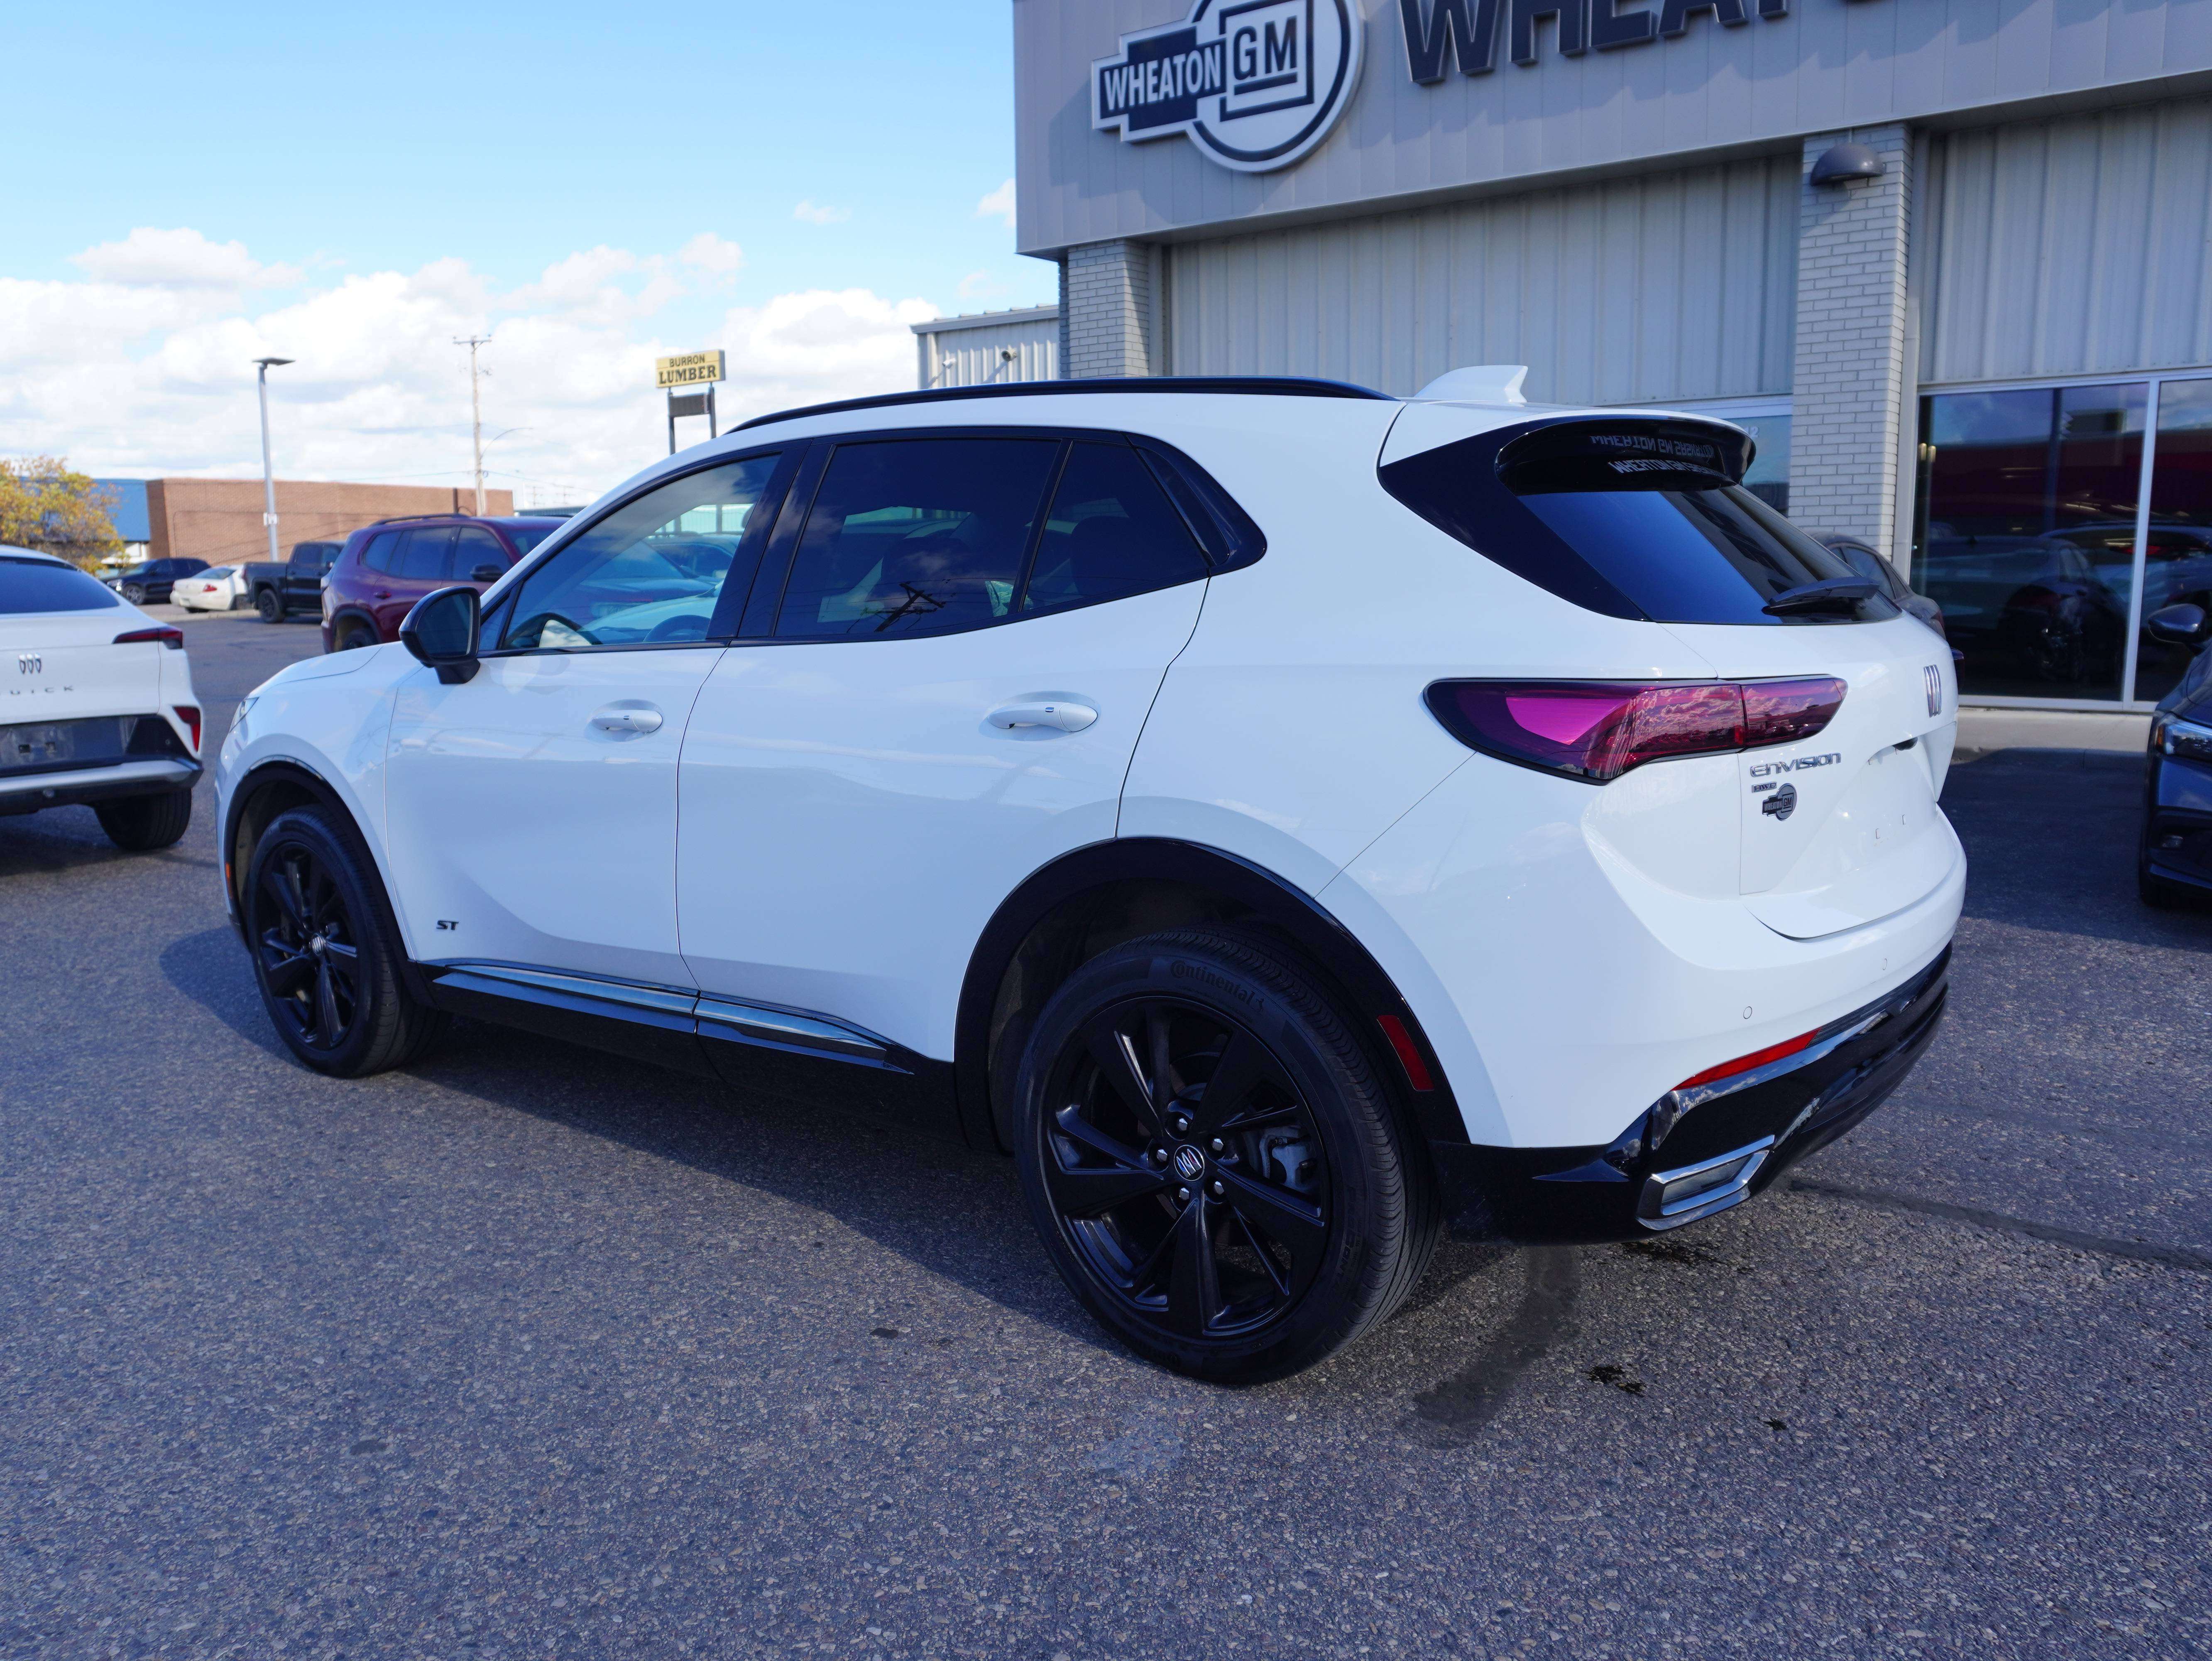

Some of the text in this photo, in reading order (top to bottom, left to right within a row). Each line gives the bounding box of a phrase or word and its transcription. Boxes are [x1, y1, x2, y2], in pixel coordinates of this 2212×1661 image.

[1104, 15, 1297, 111] WHEATON GM
[669, 354, 705, 367] BURRON
[659, 365, 717, 384] LUMBER
[10, 686, 73, 695] UICK
[1754, 782, 1776, 791] AWD
[1764, 796, 1793, 811] WHEATON GM
[436, 920, 459, 931] ST
[1170, 960, 1255, 1006] Continental
